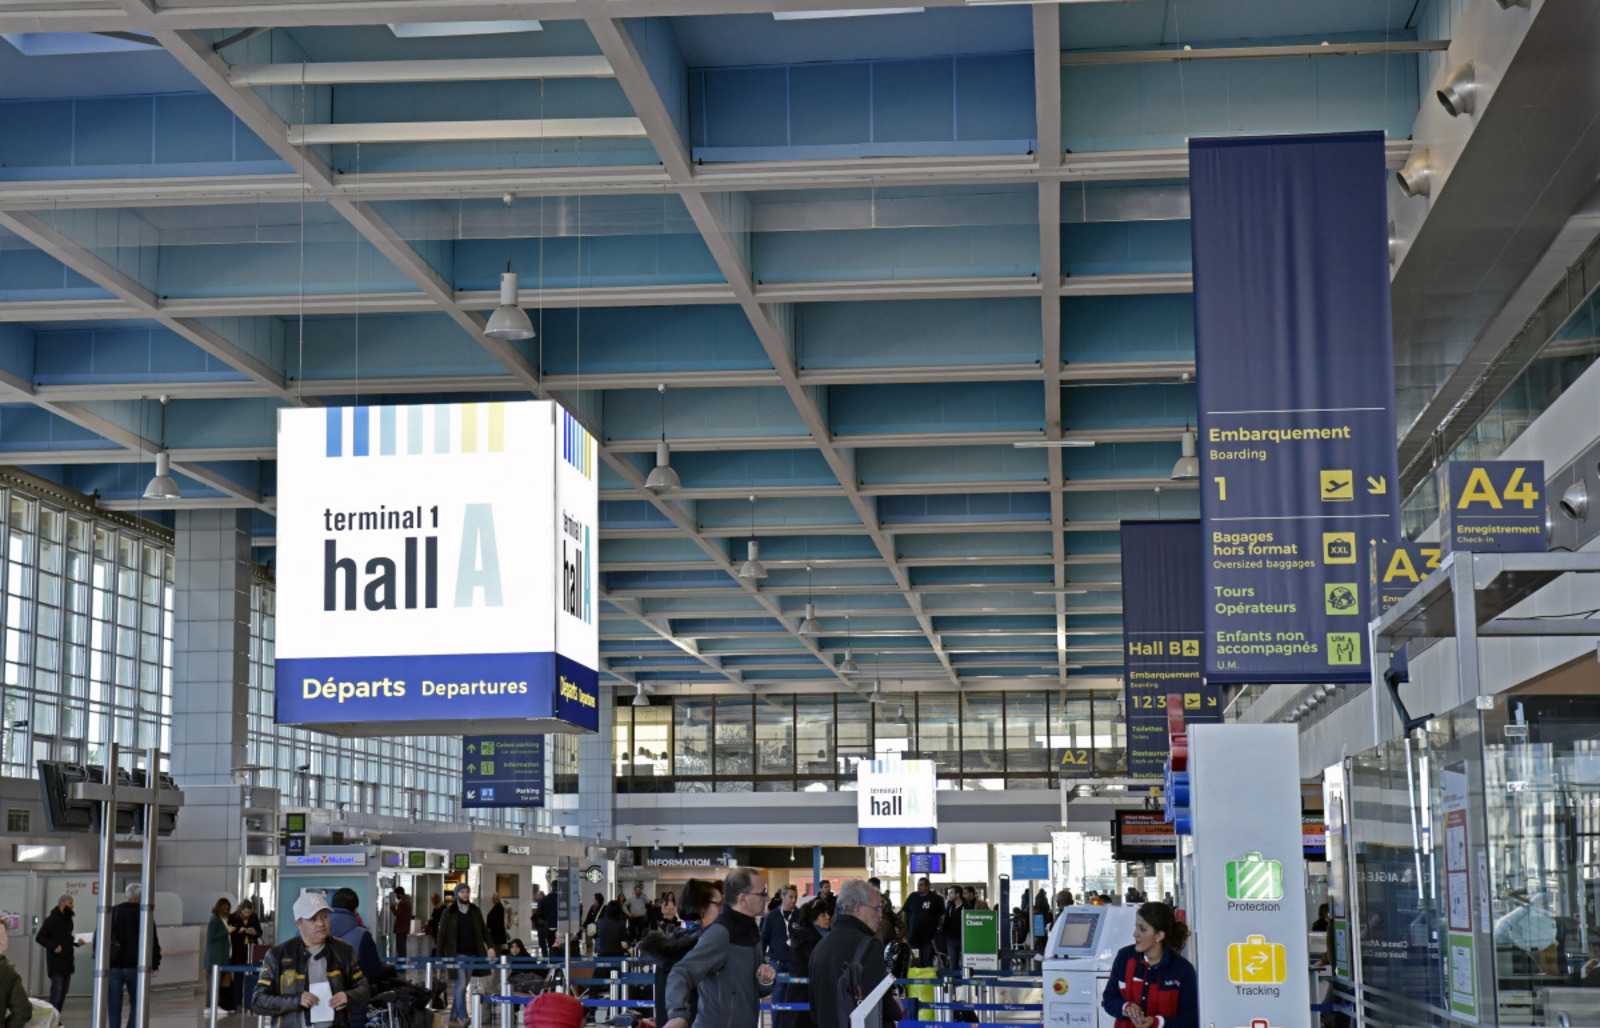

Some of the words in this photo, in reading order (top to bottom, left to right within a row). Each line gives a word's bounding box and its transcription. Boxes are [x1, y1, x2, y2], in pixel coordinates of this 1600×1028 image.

[1209, 426, 1351, 443] Embarquement
[1210, 449, 1267, 461] Boarding
[1214, 476, 1226, 500] 1
[1456, 467, 1539, 509] A4
[324, 505, 422, 531] terminal
[430, 505, 438, 528] 1
[1456, 525, 1540, 536] Enregistrement
[1213, 532, 1274, 545] Bagages
[1456, 536, 1494, 544] Check-in
[1213, 544, 1245, 556] hors
[1248, 543, 1298, 555] format
[324, 536, 438, 611] hall
[454, 503, 504, 608] A
[1213, 560, 1263, 569] Oversized
[1266, 559, 1316, 570] baggages
[563, 540, 582, 620] hall
[584, 524, 591, 625] A
[1214, 586, 1255, 597] Tours
[1215, 602, 1297, 616] Opérateurs
[1217, 630, 1272, 642] Enfants
[1276, 631, 1304, 641] non
[1129, 641, 1163, 655] Hall
[1169, 641, 1181, 655] B
[1217, 642, 1318, 656] accompagnés
[1130, 672, 1200, 680] Embarquement
[302, 677, 406, 703] Départs
[421, 680, 528, 699] Departures
[1061, 749, 1088, 765] A2
[870, 796, 902, 816] hall
[1227, 902, 1281, 911] Protection
[1235, 985, 1280, 997] Tracking
